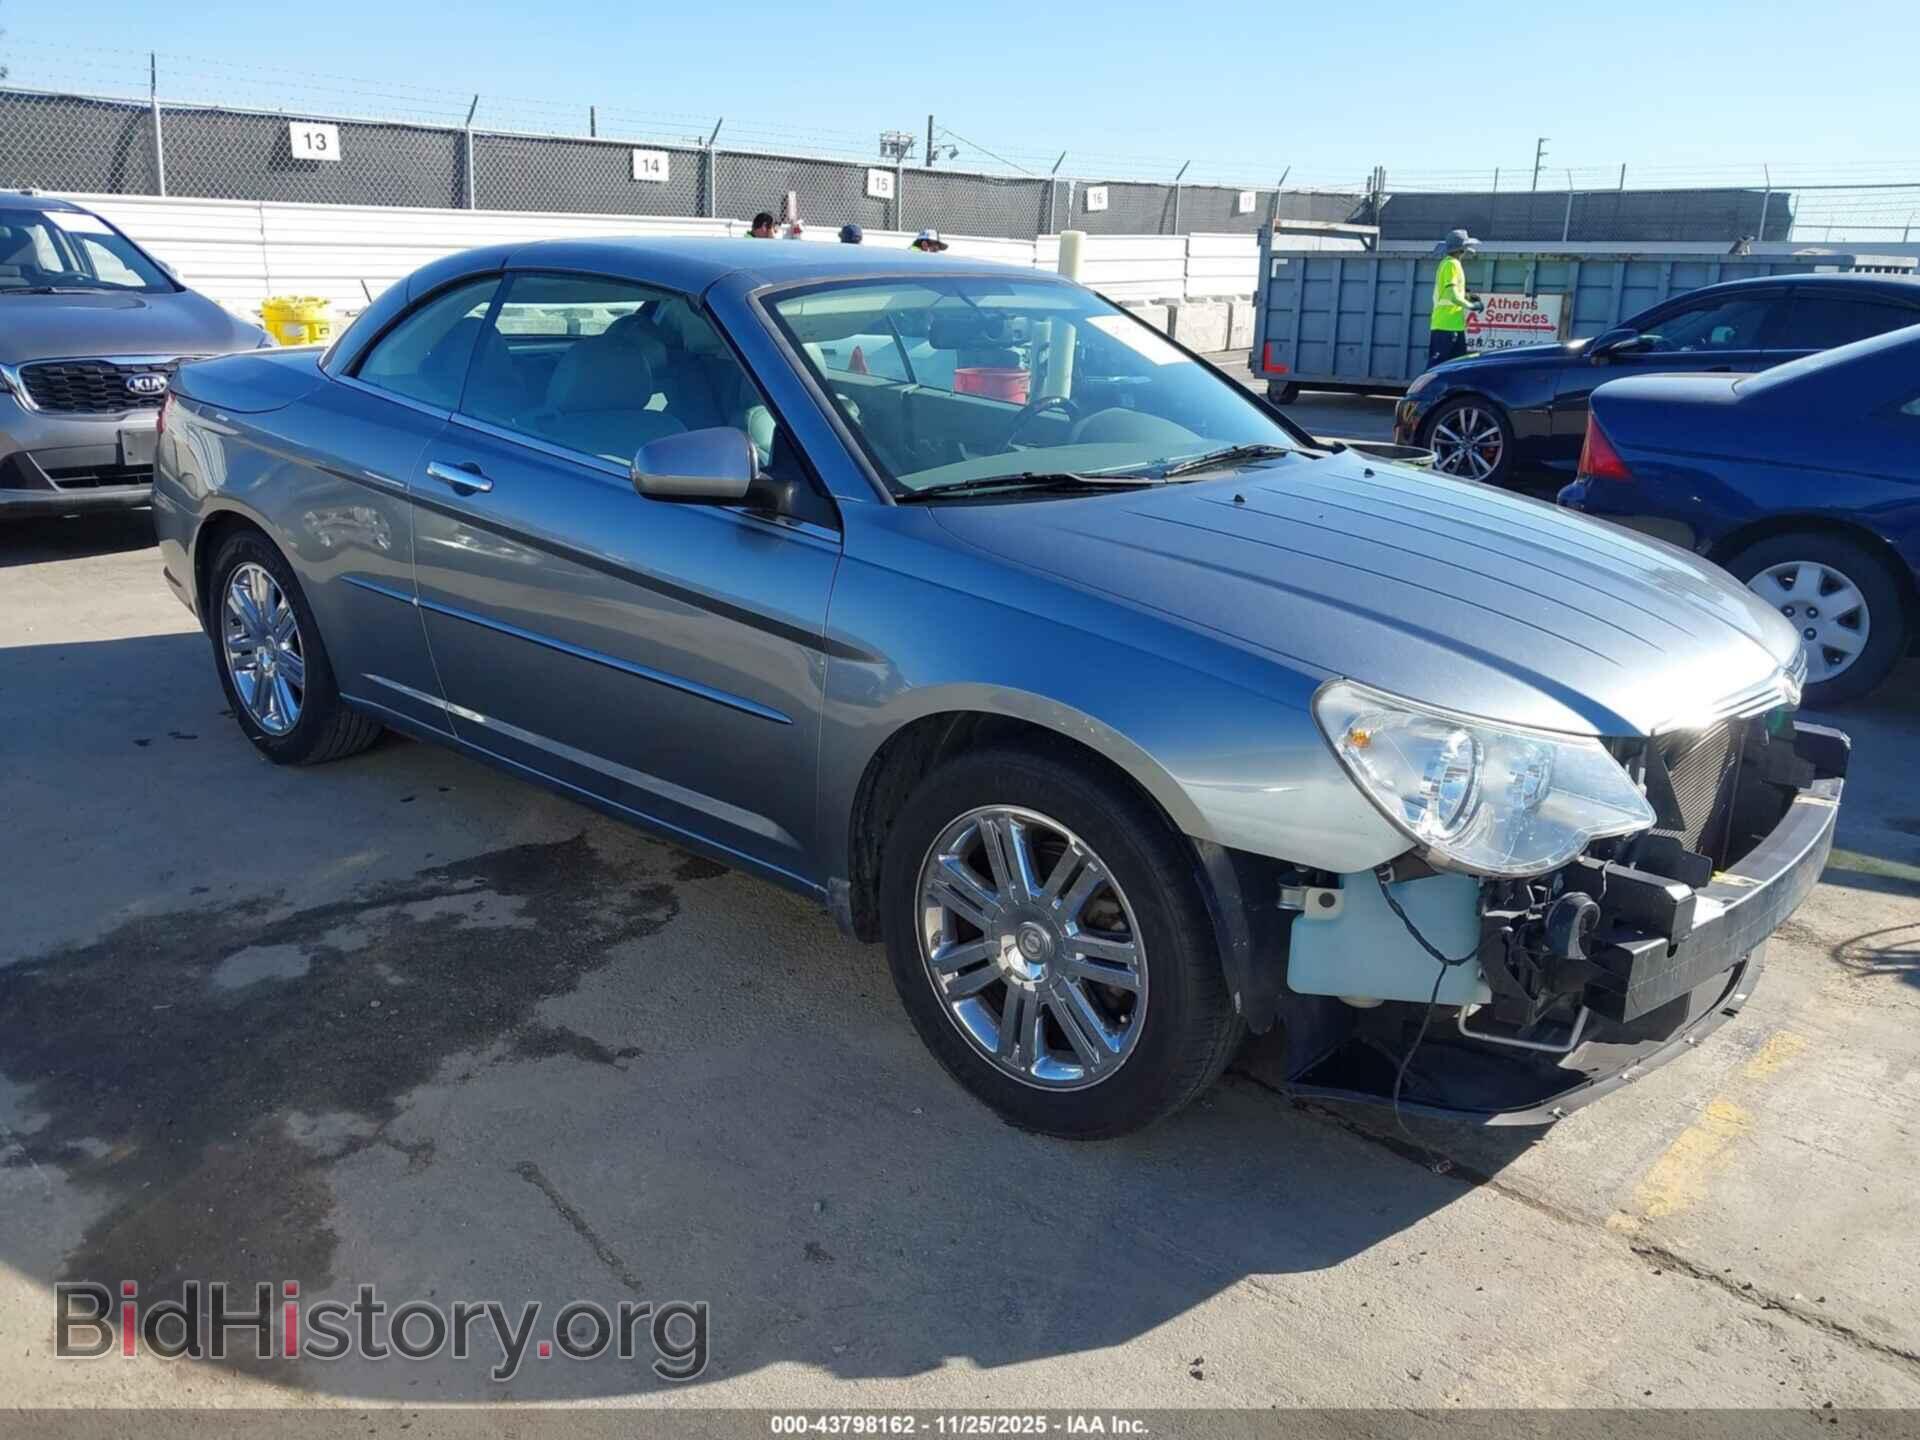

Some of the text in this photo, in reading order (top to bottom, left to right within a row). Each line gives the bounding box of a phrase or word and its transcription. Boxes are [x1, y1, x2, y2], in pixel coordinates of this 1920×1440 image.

[303, 133, 327, 151] 13
[643, 158, 660, 173] 14
[875, 177, 888, 191] 15
[1487, 297, 1538, 310] Athens
[1485, 310, 1549, 323] Services
[134, 376, 162, 391] KIA
